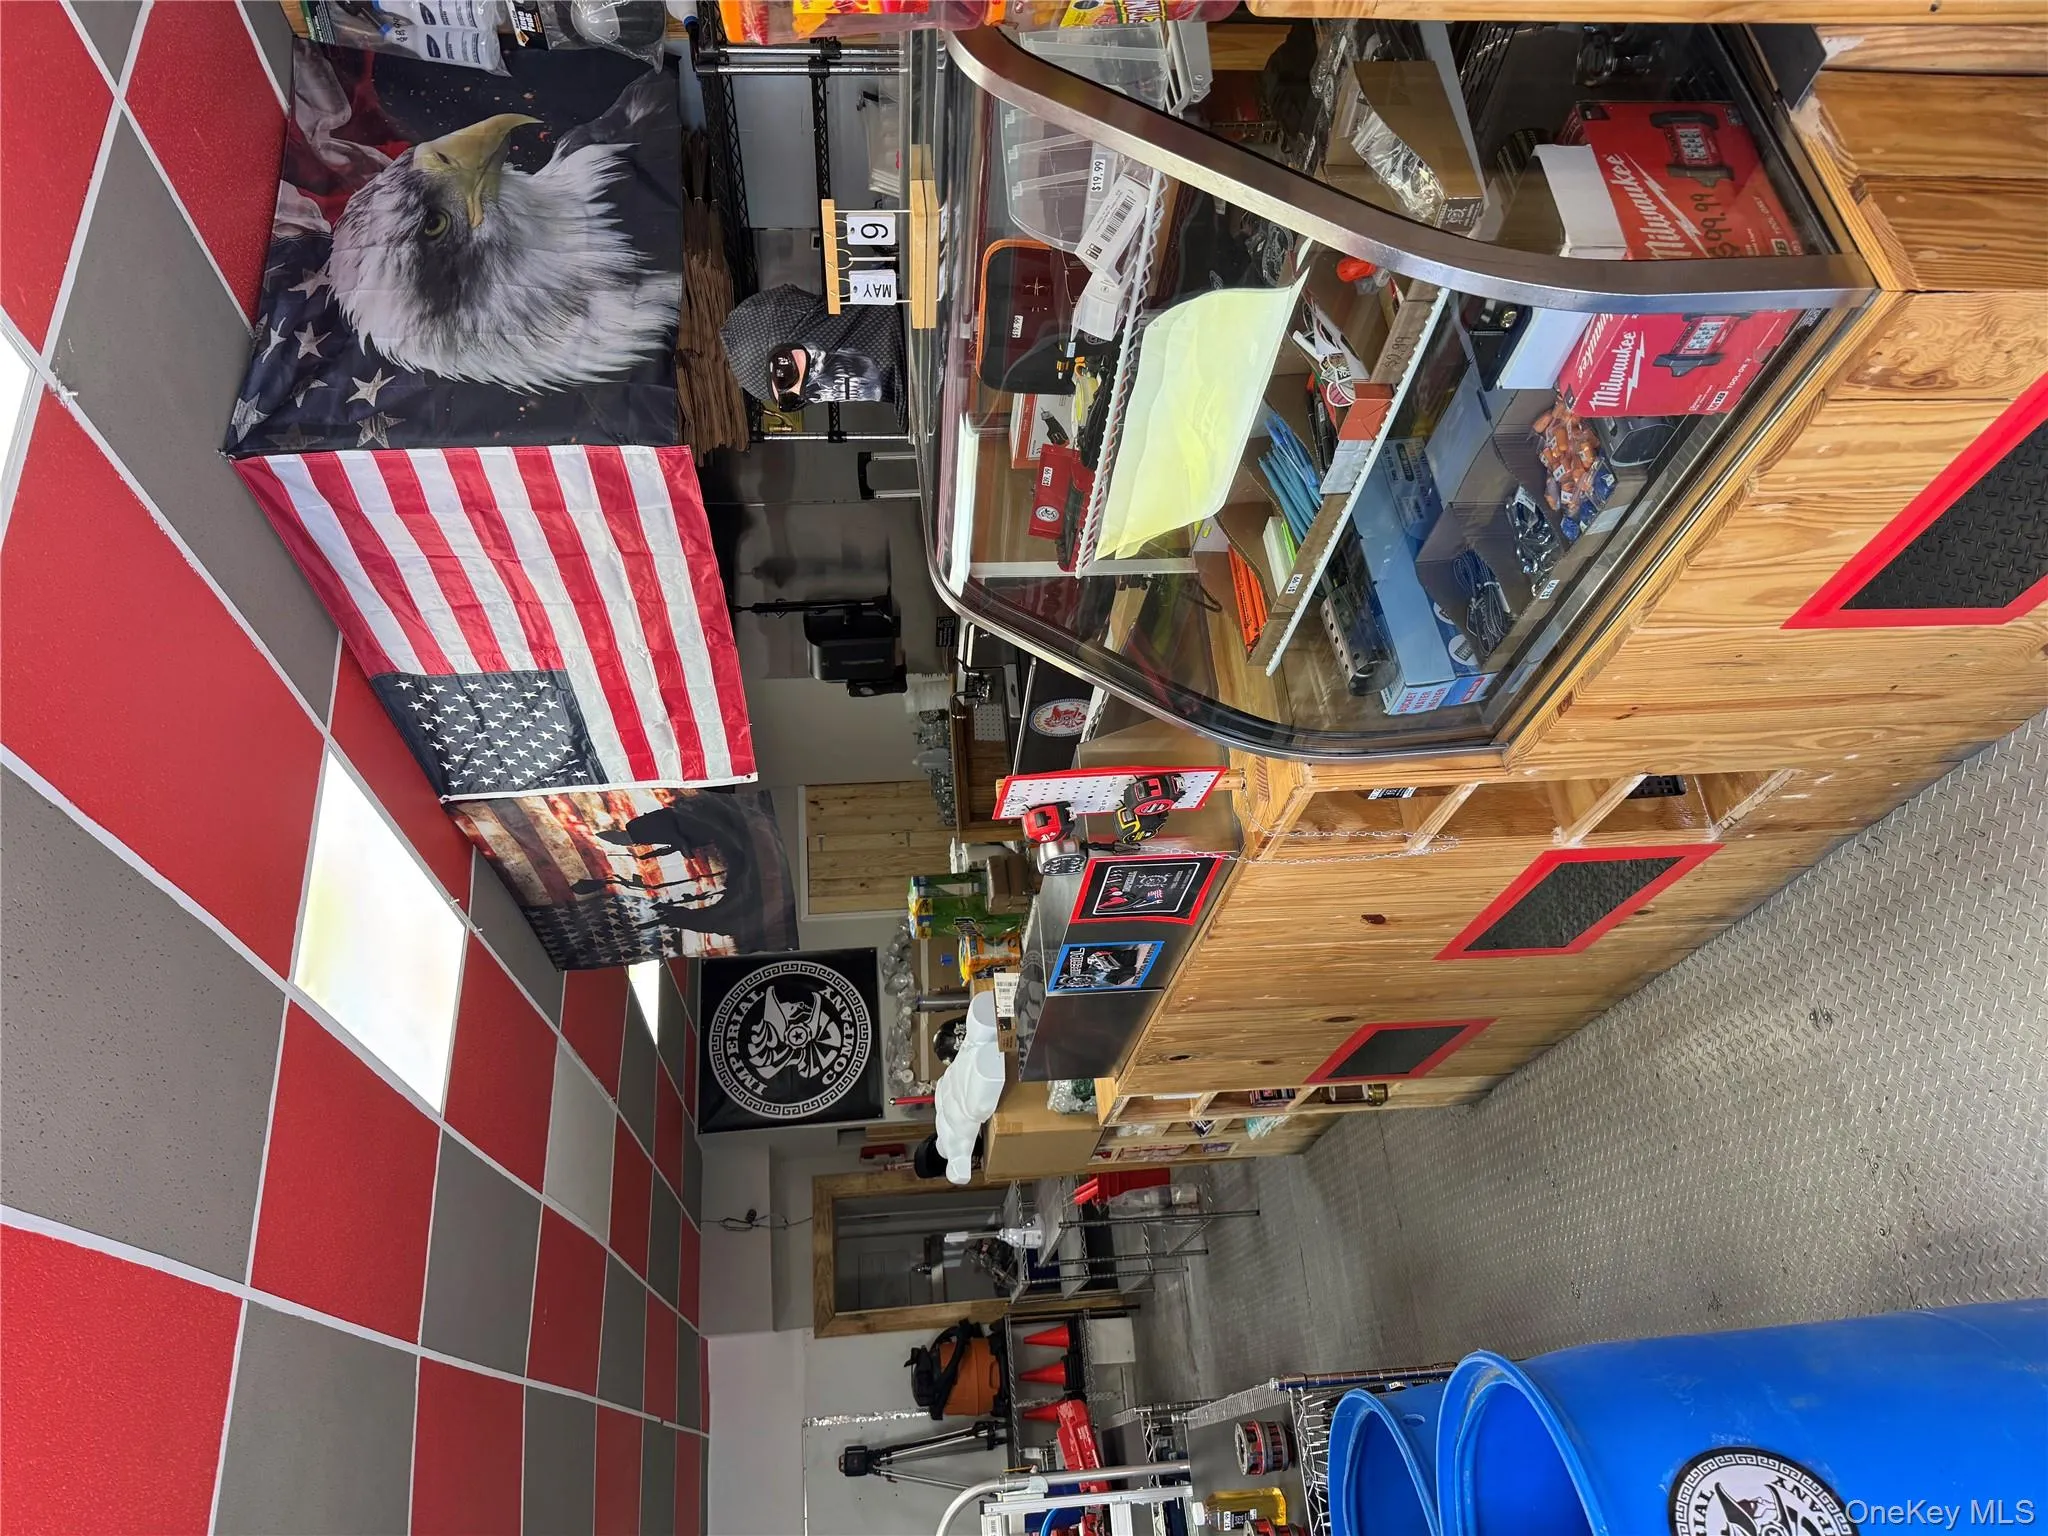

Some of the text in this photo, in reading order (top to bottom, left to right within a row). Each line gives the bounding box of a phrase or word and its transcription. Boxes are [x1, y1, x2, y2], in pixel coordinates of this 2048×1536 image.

[518, 11, 528, 31] Knee
[526, 12, 536, 32] Pads
[1090, 160, 1104, 192] $19.99
[1604, 154, 1692, 260] Milwaukee
[860, 224, 889, 239] 9
[863, 283, 892, 298] MAY
[1588, 330, 1636, 412] Milwaukee
[1397, 692, 1418, 713] BUCKET
[1413, 690, 1432, 710] WATER
[726, 988, 768, 1096] IMPERIAL
[820, 984, 855, 1085] COMPANY
